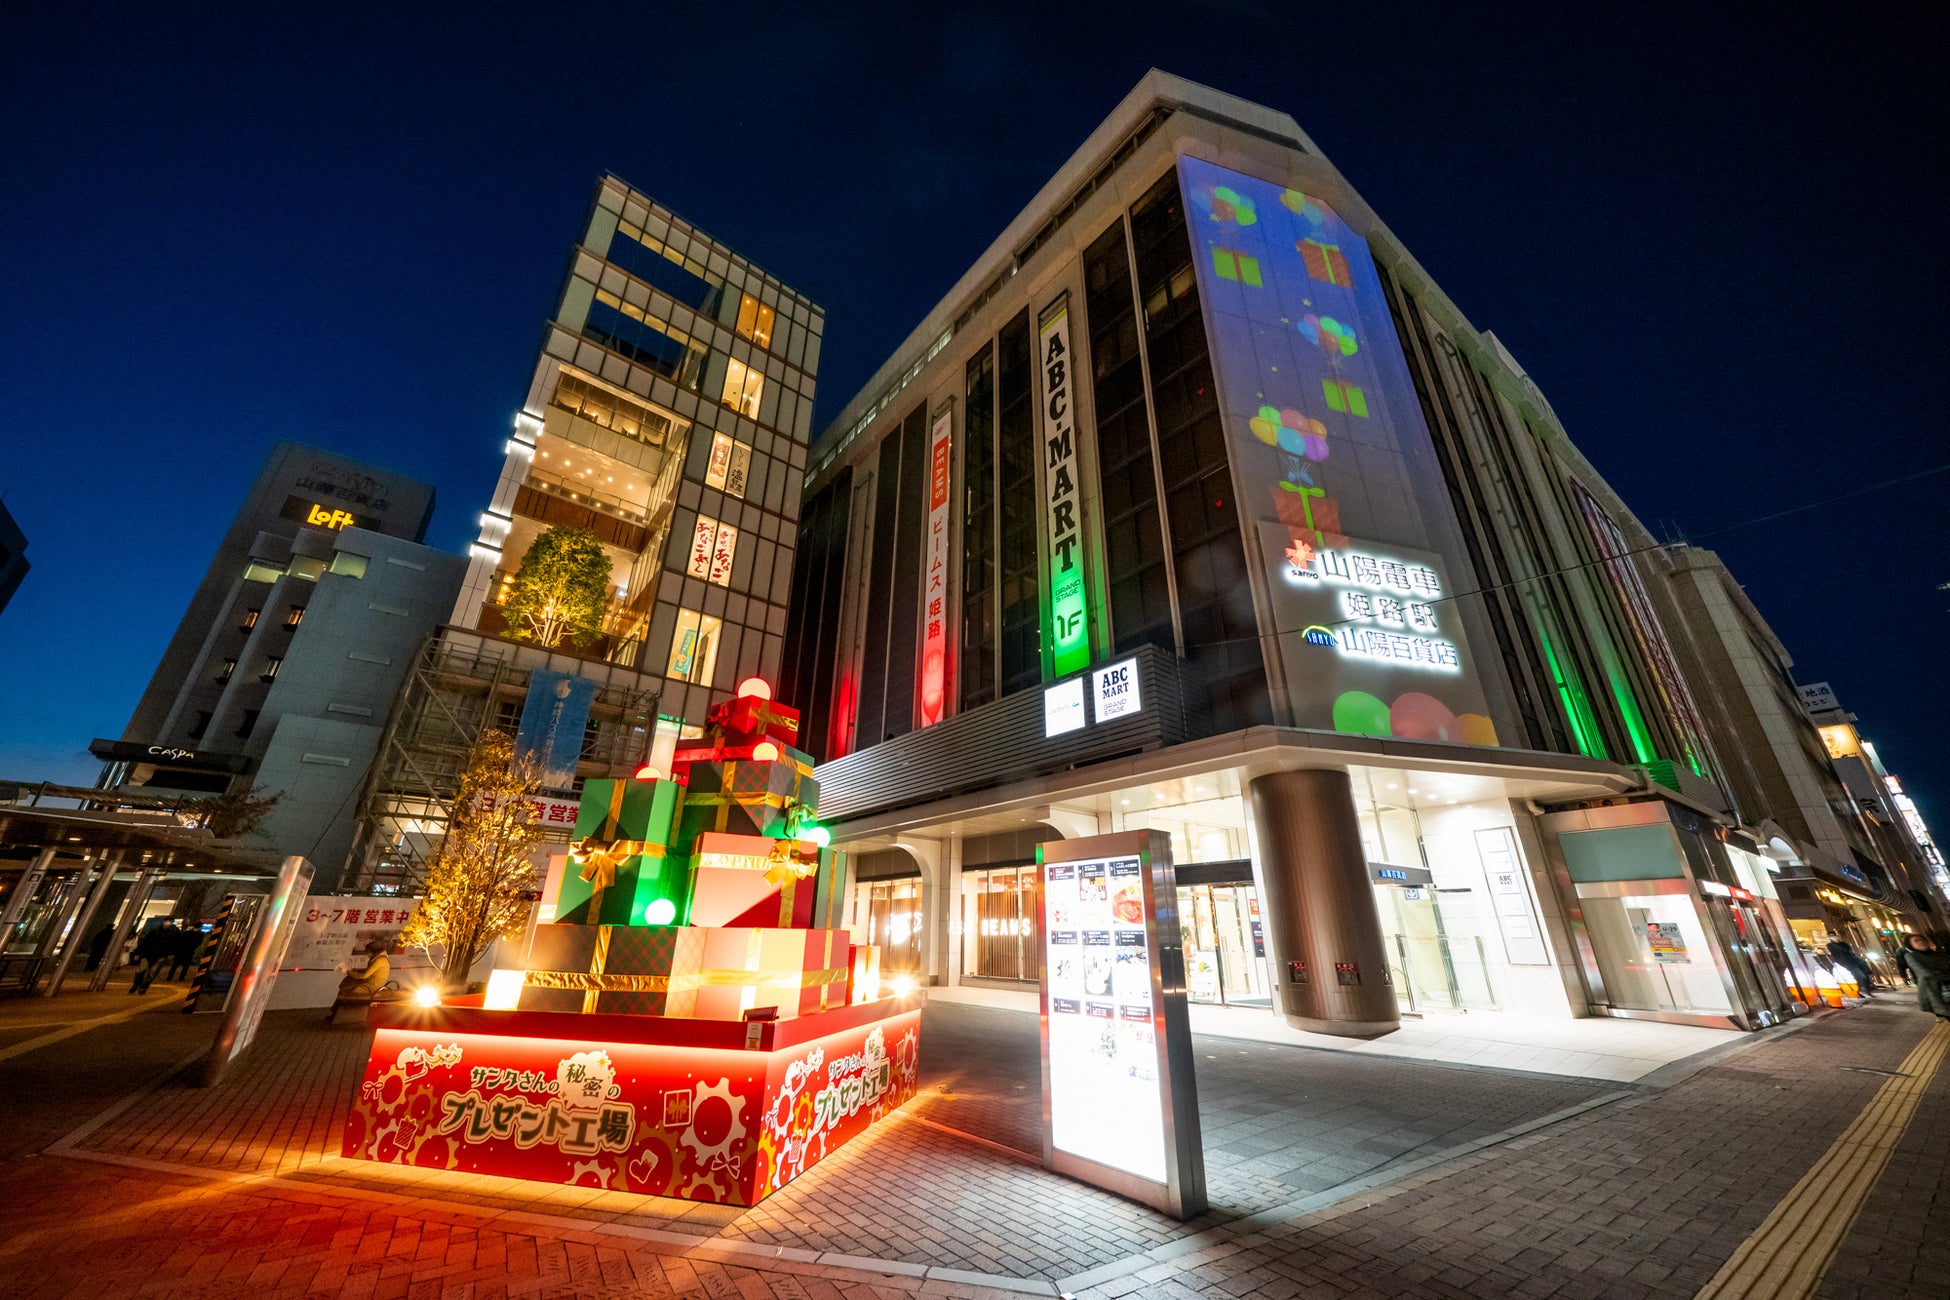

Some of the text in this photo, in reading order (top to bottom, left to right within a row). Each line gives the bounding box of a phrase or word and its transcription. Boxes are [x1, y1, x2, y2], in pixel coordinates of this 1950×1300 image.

[935, 447, 945, 499] BEAMS
[1055, 579, 1081, 596] GRAND
[1321, 551, 1440, 594] 山陽電車
[1055, 587, 1080, 603] STAGE
[1347, 592, 1437, 628] 姫路駅
[1057, 609, 1082, 639] 1F
[1342, 628, 1458, 666] 山陽百貨店
[1102, 667, 1128, 688] ABC
[1103, 682, 1129, 699] MART
[1103, 698, 1127, 711] GRAND
[1104, 705, 1124, 716] STAGE
[818, 1064, 888, 1123] プレゼント工場
[442, 1098, 630, 1148] プレゼント工場
